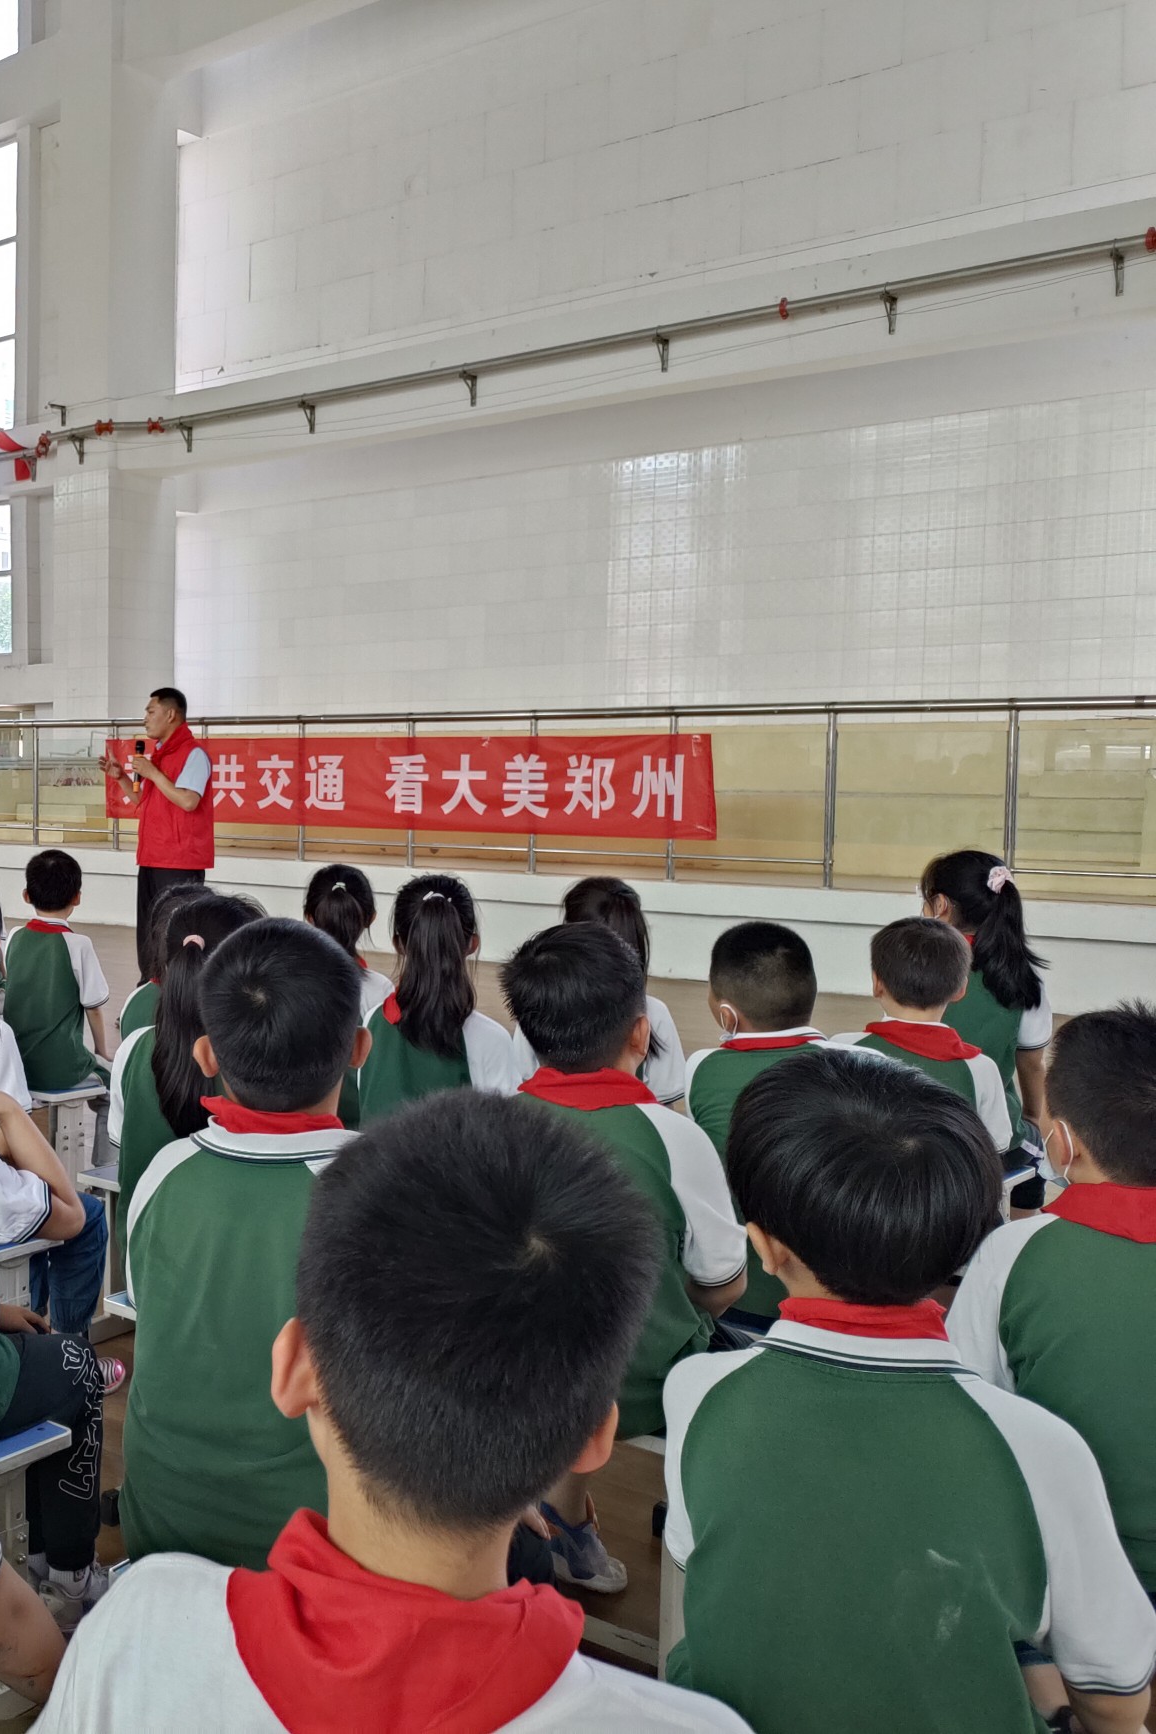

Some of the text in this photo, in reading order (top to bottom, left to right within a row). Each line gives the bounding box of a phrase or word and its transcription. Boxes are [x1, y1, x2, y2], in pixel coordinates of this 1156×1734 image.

[385, 754, 685, 822] 看大美郑州
